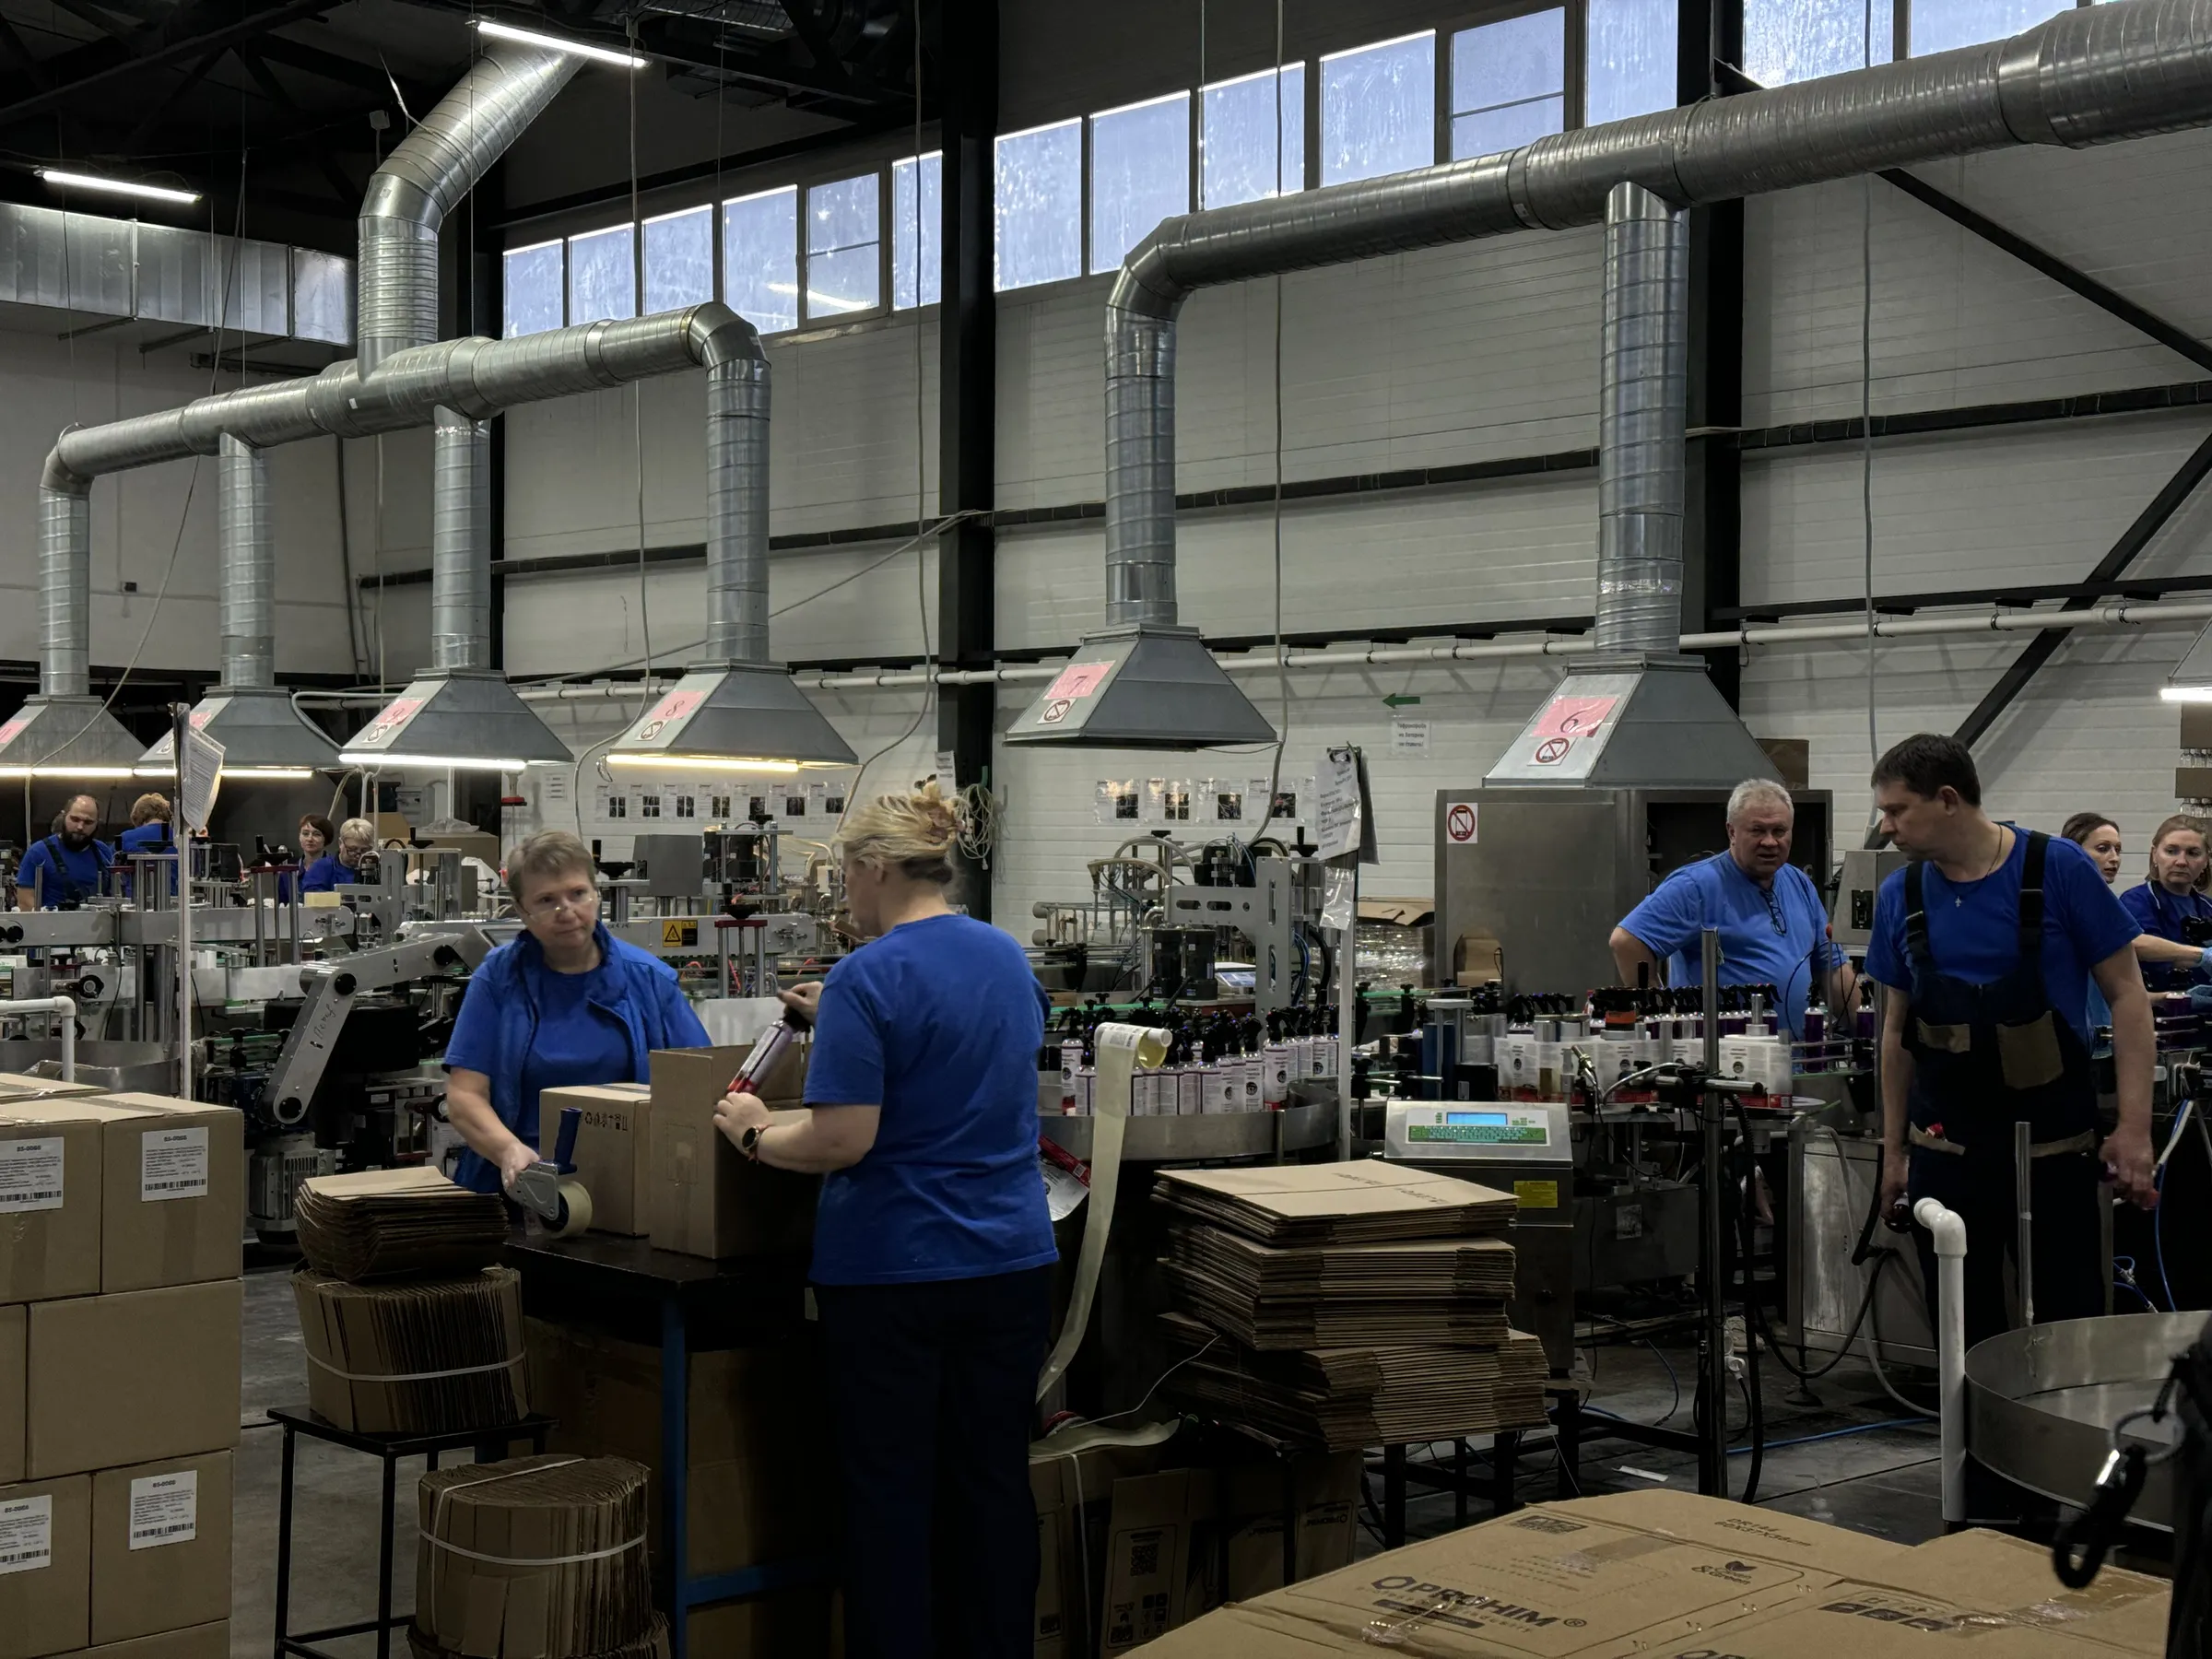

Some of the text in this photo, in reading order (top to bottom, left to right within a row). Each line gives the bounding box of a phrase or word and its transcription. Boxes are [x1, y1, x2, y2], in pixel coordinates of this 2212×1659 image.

[1068, 675, 1088, 695] 7
[665, 700, 680, 718] 8
[1559, 710, 1589, 734] 6
